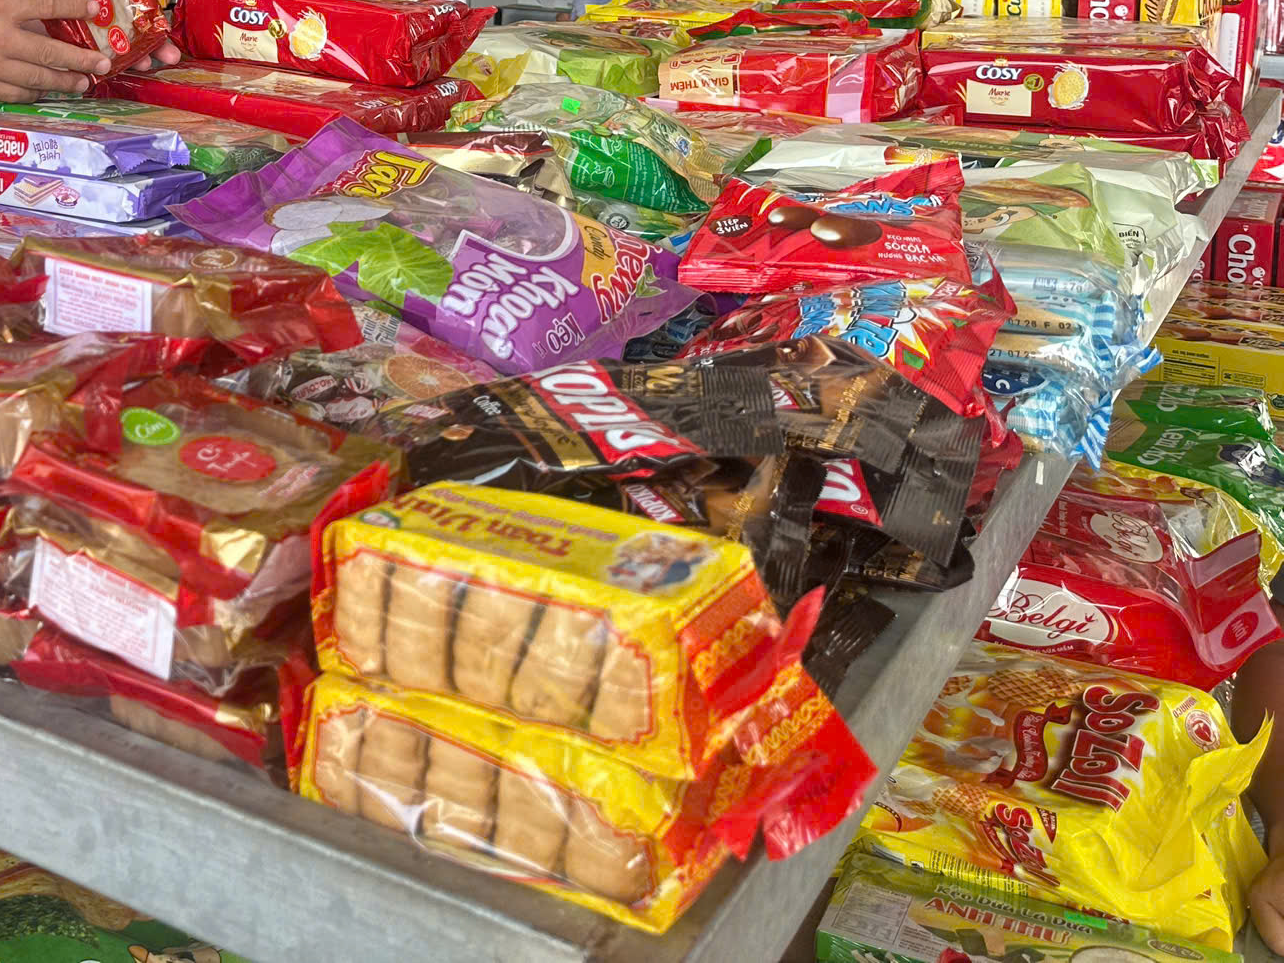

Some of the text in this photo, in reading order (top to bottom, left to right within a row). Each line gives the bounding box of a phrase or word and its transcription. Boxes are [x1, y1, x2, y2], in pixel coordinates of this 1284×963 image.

[229, 6, 269, 26] COSY
[240, 32, 259, 43] Marie
[975, 64, 1023, 80] COSY
[1227, 233, 1256, 285] Cho
[472, 394, 502, 417] Coffee
[622, 483, 684, 523] KOPIKO
[990, 589, 1096, 640] Belgi
[924, 895, 997, 927] ANH
[997, 917, 1073, 947] THƯ
